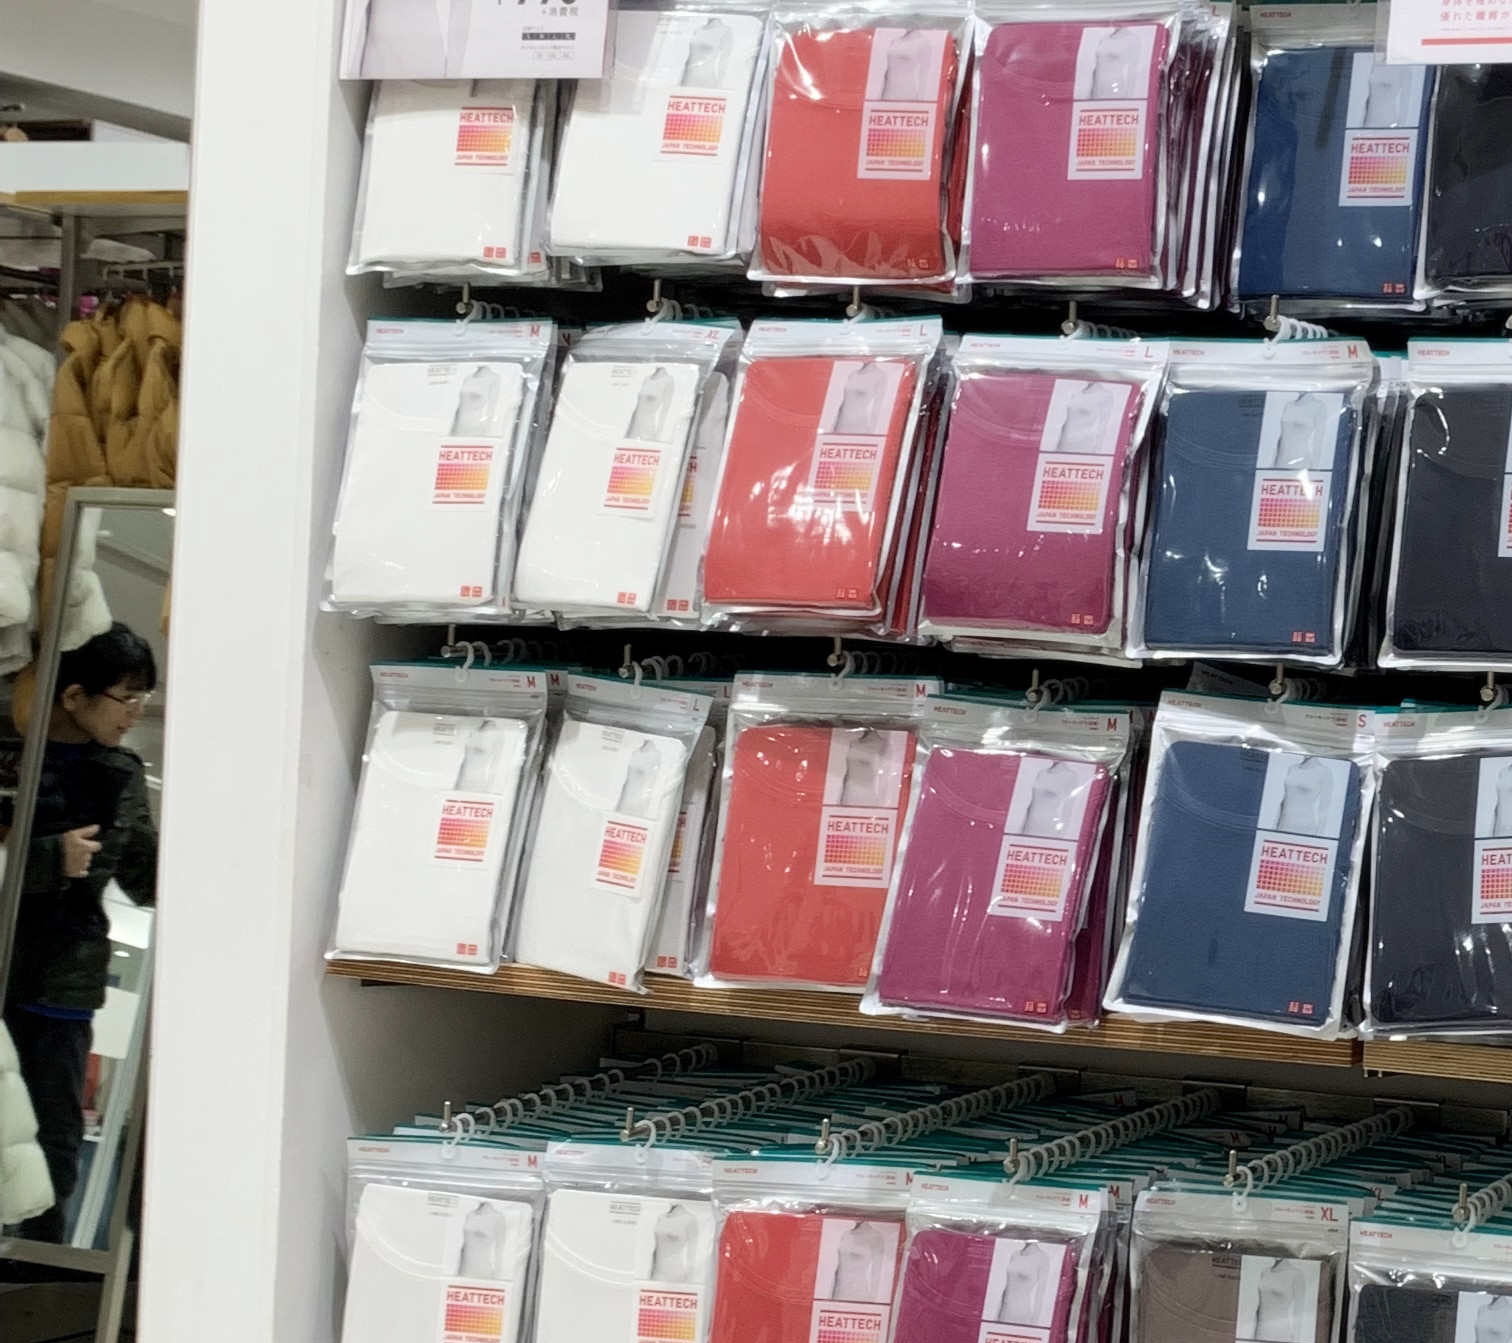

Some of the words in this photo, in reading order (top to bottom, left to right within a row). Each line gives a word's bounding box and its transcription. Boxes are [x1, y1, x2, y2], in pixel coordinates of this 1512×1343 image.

[667, 98, 726, 114] HEATTECH
[869, 114, 928, 128] HEATTECH
[1078, 112, 1139, 127] HEATTECH
[1351, 140, 1410, 156] HEATTECH
[1347, 344, 1358, 357] M
[1042, 466, 1104, 480] HEATTECH
[1261, 484, 1324, 497] HEATTEH
[828, 820, 888, 834] HEATTECH
[1006, 848, 1068, 867] HEATTECH
[1261, 845, 1328, 865] HEATTECH
[1320, 1206, 1337, 1221] XL
[446, 1291, 505, 1305] HEATTECH
[818, 1315, 880, 1331] HEATTECH
